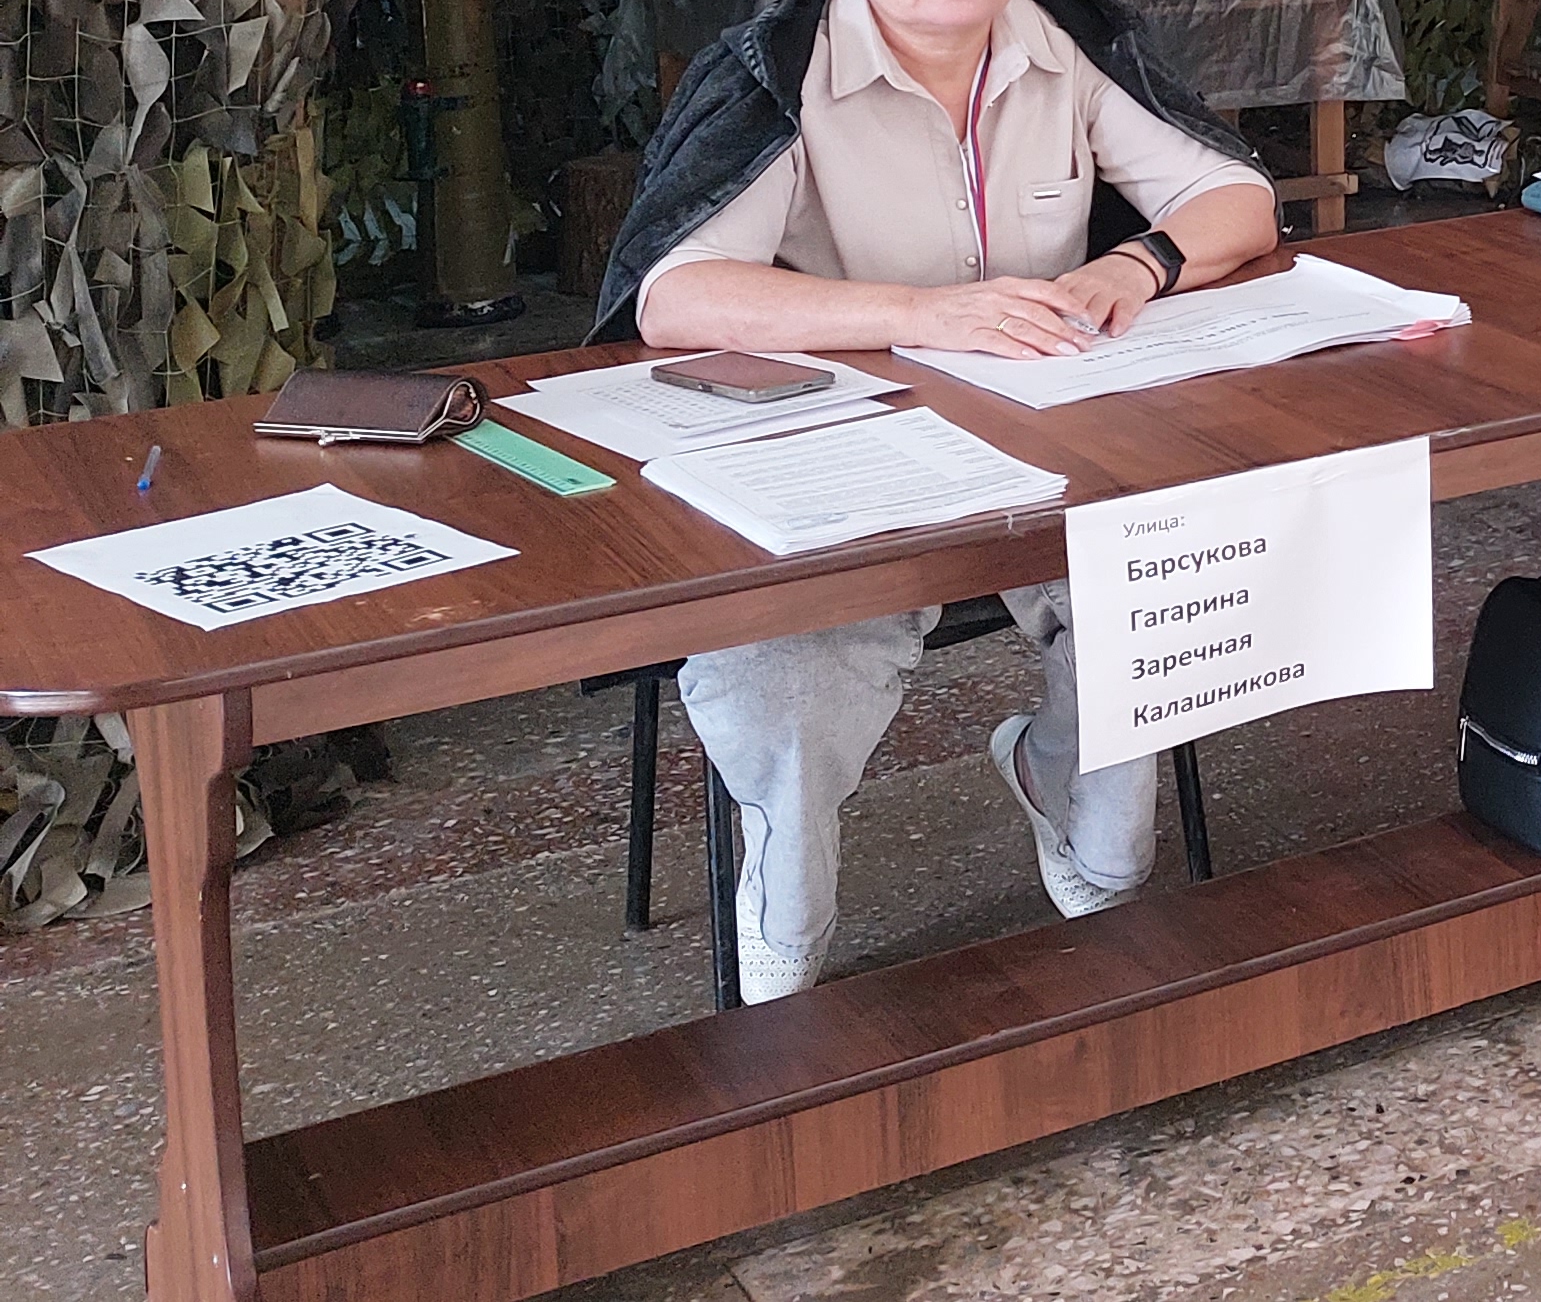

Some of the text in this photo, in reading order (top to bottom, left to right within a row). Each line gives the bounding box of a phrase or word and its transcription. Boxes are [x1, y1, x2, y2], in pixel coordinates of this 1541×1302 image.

[1122, 513, 1187, 539] Улица:
[1126, 536, 1268, 583] Барсукова
[1129, 587, 1250, 633] Гагарина
[1130, 631, 1253, 681] Заречная
[1132, 660, 1306, 729] Калашникова
